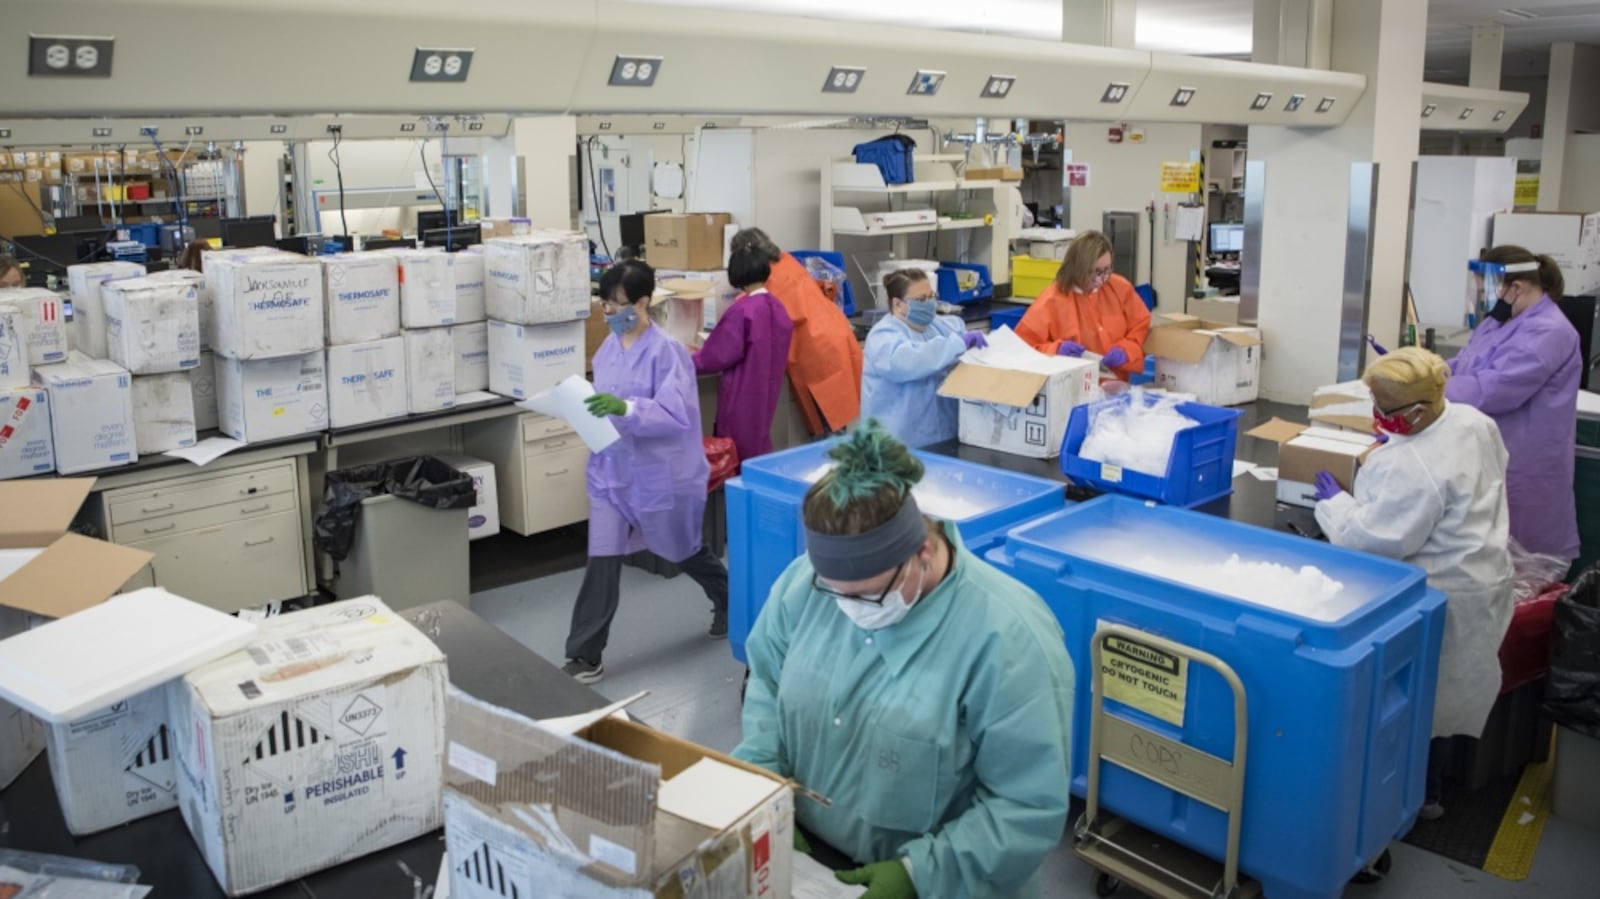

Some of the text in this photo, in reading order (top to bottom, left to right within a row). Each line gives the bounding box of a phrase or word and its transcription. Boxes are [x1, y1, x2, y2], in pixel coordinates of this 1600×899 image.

[338, 288, 390, 301] THERMOSAFE
[533, 345, 577, 359] THERMOSAFE
[1116, 641, 1165, 665] WARNING
[1110, 658, 1169, 686] CRYOGENIC
[1102, 666, 1178, 700] DO NOT TOUCH
[344, 707, 378, 723] UN3373
[305, 765, 385, 800] PERISHABLE
[395, 771, 406, 780] UP
[324, 785, 370, 805] INSULATED
[284, 804, 296, 815] UP
